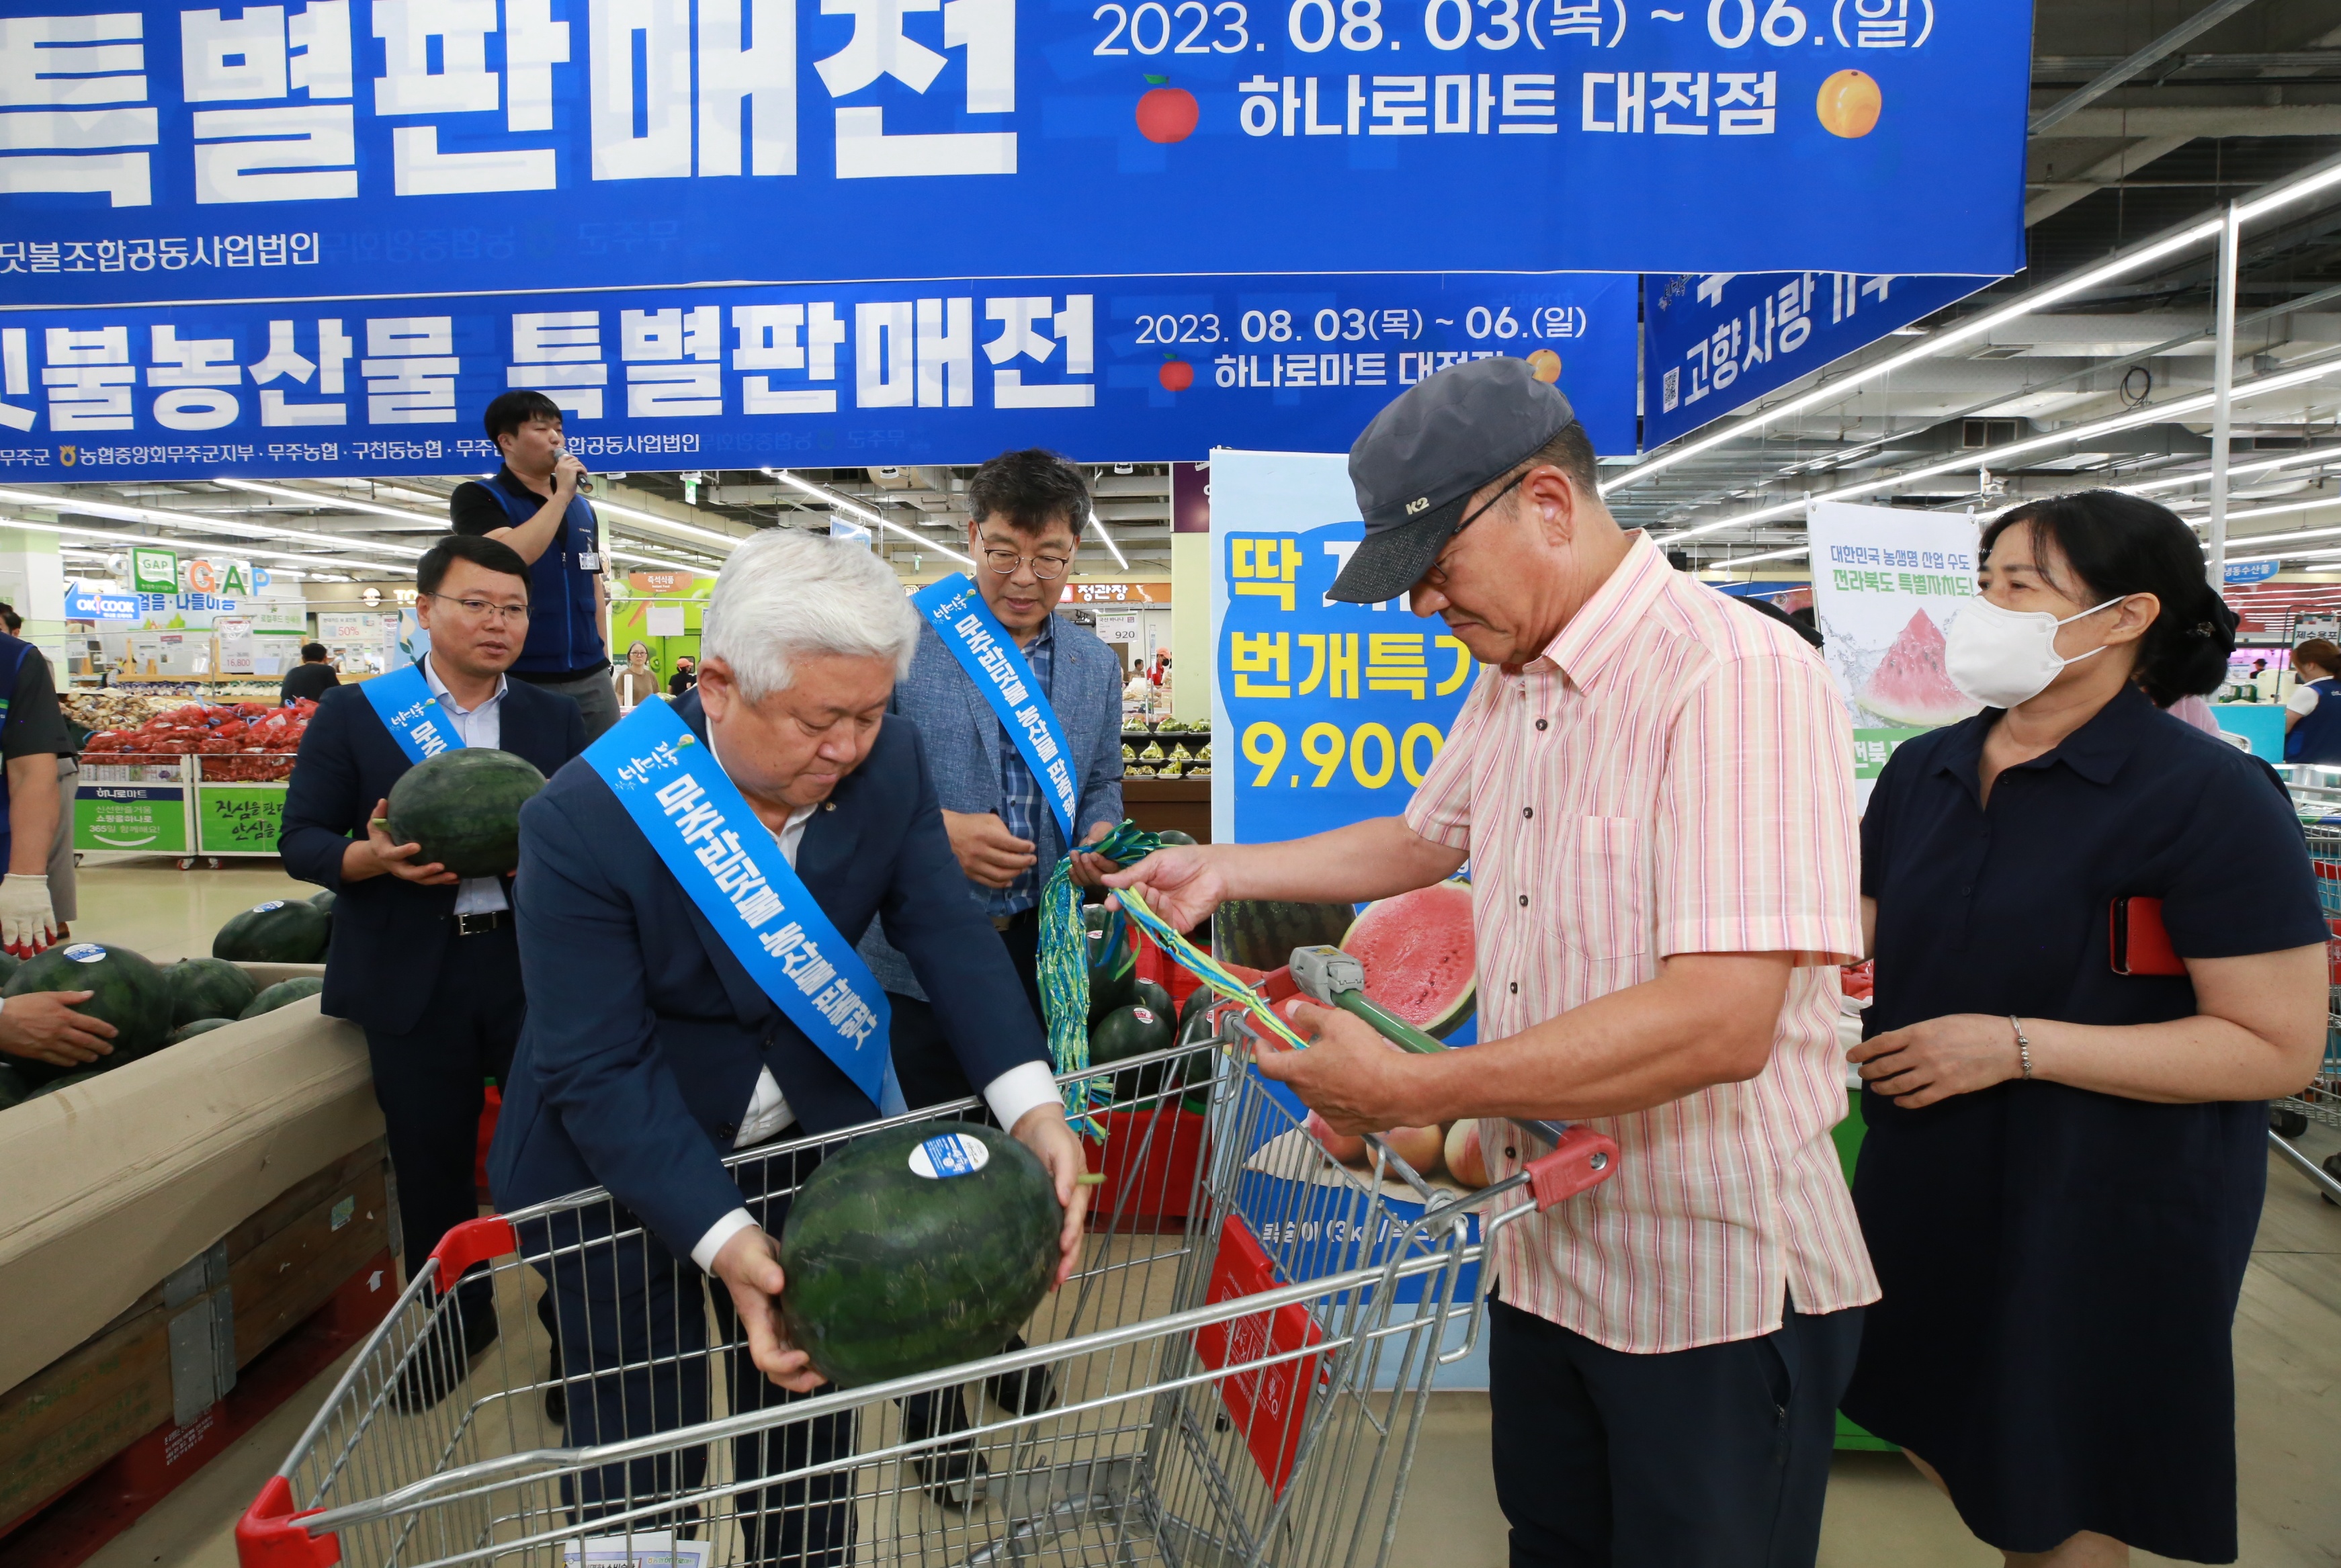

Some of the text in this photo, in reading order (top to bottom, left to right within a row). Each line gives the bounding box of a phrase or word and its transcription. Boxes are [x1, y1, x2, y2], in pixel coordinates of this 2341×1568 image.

[1093, 2, 1265, 56] 2023.
[1288, 0, 1400, 52] 08.
[1424, 0, 1626, 50] 03(목)
[1707, 0, 1934, 49] 06.(일)
[0, 0, 1017, 208] 특별판매전
[1239, 71, 1777, 136] 하나로마트 대전점
[1136, 314, 1228, 345] 2023.
[1240, 309, 1301, 341] 08.
[1314, 308, 1423, 341] 03(목)
[1465, 306, 1587, 339] 06.(일)
[1685, 272, 1815, 406] 고향사랑
[507, 294, 1095, 419] 특별판매전
[1214, 353, 1387, 388] 하나로마트
[0, 449, 50, 466] 무주군
[80, 444, 254, 466] 농협중앙회무주군지부
[268, 443, 338, 462] 무주농협
[352, 439, 441, 460] 구천동농협
[1406, 497, 1430, 515] K2
[143, 559, 168, 570] GAP
[1830, 545, 1970, 570] 대한민국 농생명 산업 수도
[190, 560, 271, 596] GAP
[647, 575, 675, 584] 즉석식품
[1232, 539, 1302, 611] 딱
[1833, 569, 1975, 597] 전라북도 특별자치도!
[1078, 584, 1128, 602] 정관장
[338, 626, 359, 636] 50%
[1115, 630, 1136, 639] 920
[226, 658, 250, 667] 16,800
[954, 613, 1029, 708] 무주반딧불
[1015, 705, 1059, 765] 농산물
[96, 787, 148, 799] 하나로마트
[216, 800, 260, 821] 진심을
[654, 773, 785, 930] 무주반딧불
[759, 920, 838, 997] 농산물
